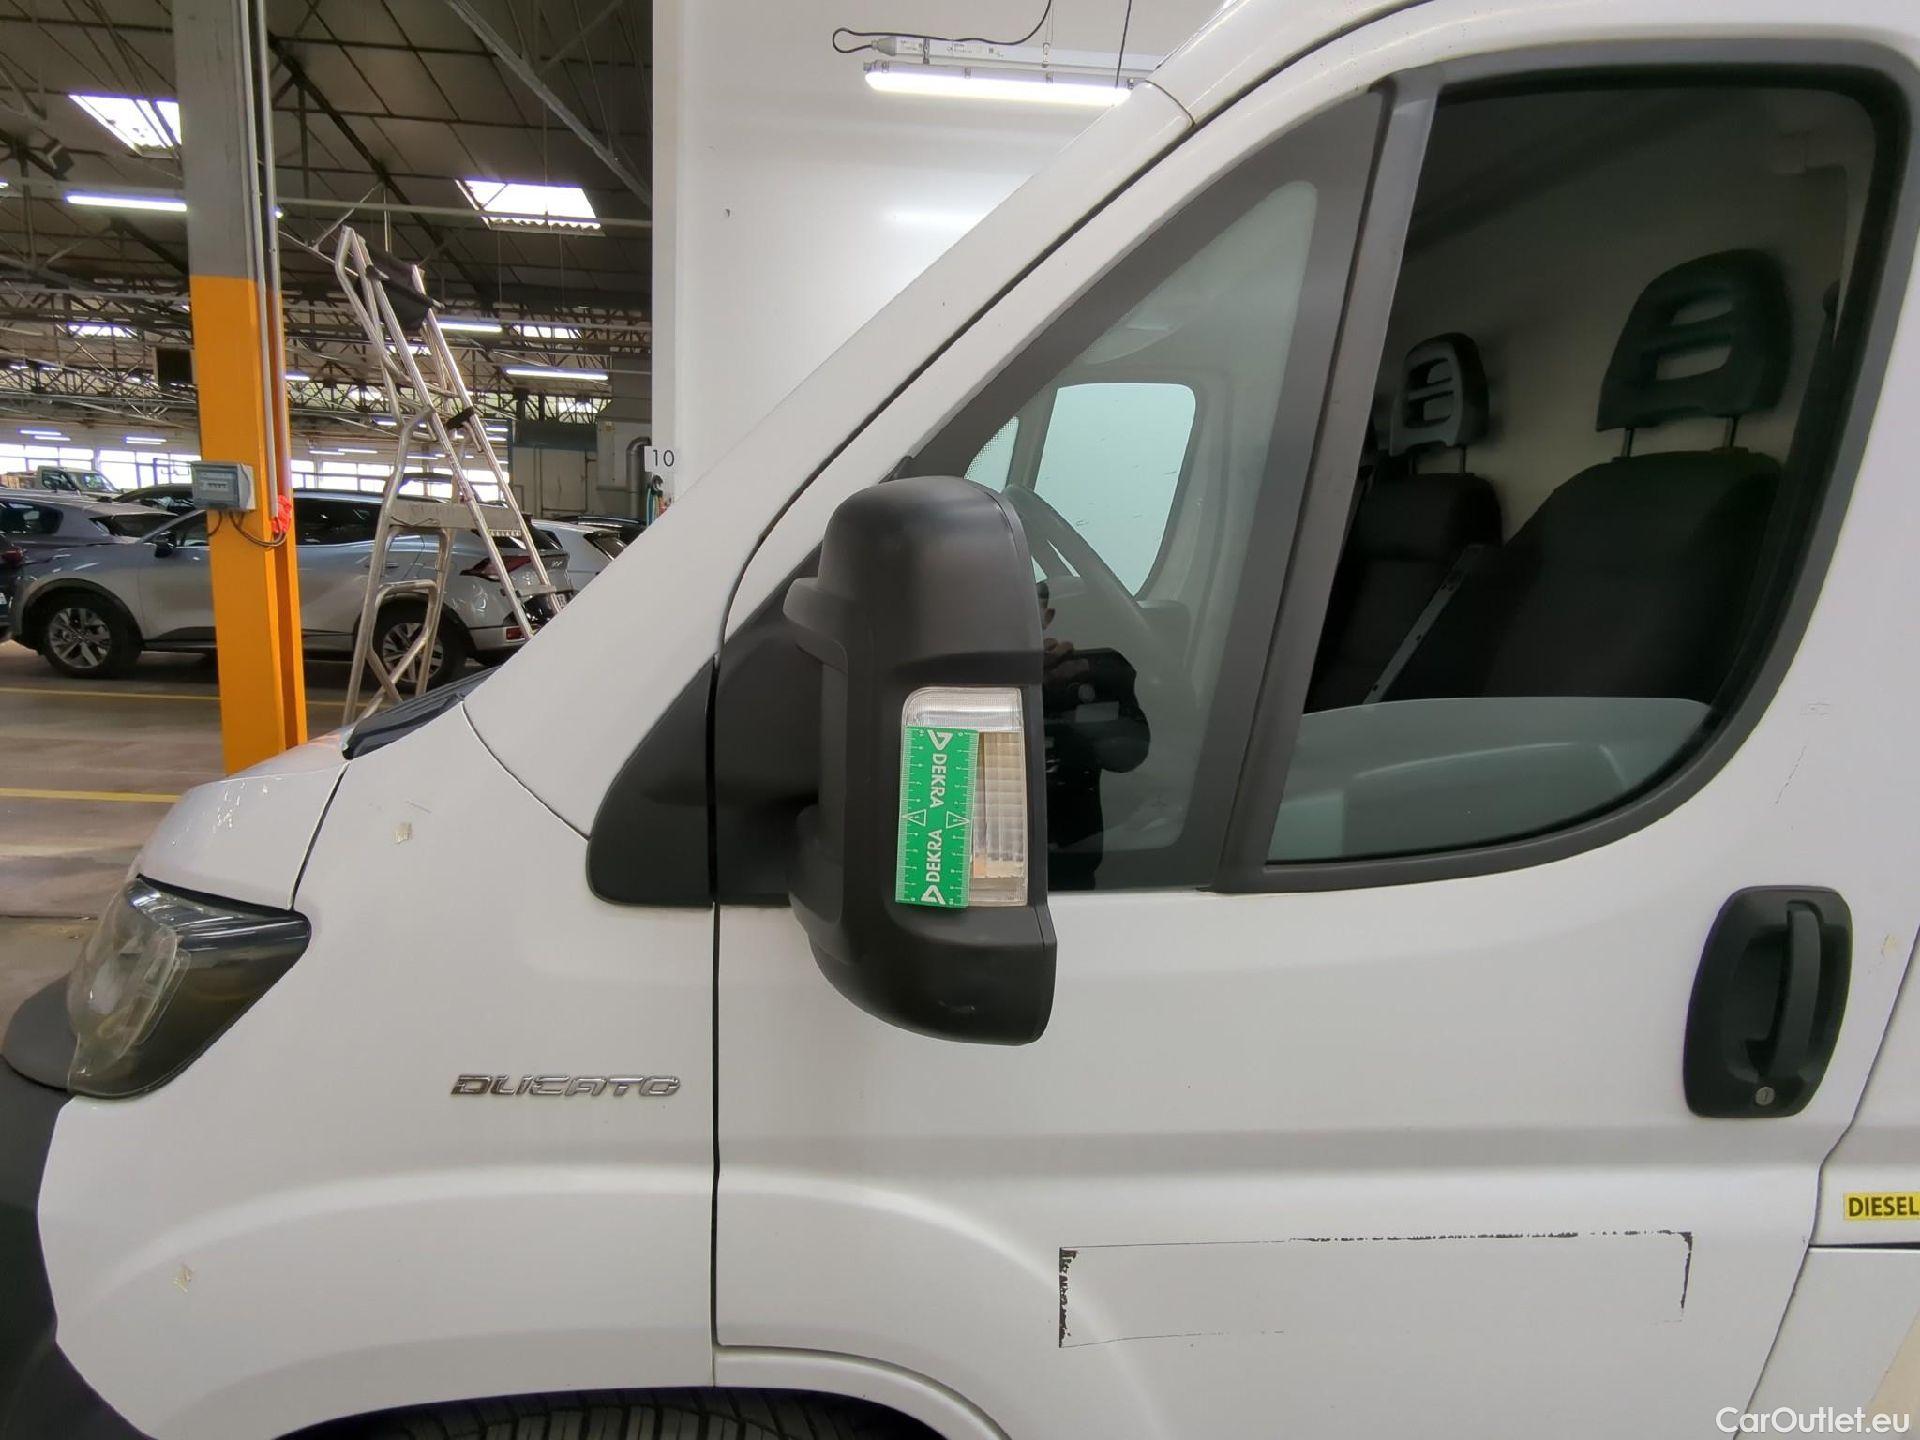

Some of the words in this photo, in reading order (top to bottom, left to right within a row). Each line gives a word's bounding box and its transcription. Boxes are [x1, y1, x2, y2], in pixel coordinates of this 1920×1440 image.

[653, 449, 675, 467] 10
[930, 753, 947, 808] DEKRA
[926, 829, 942, 882] DEKRA
[450, 1074, 681, 1097] DUCATO
[1848, 1196, 1919, 1217] DIESEL
